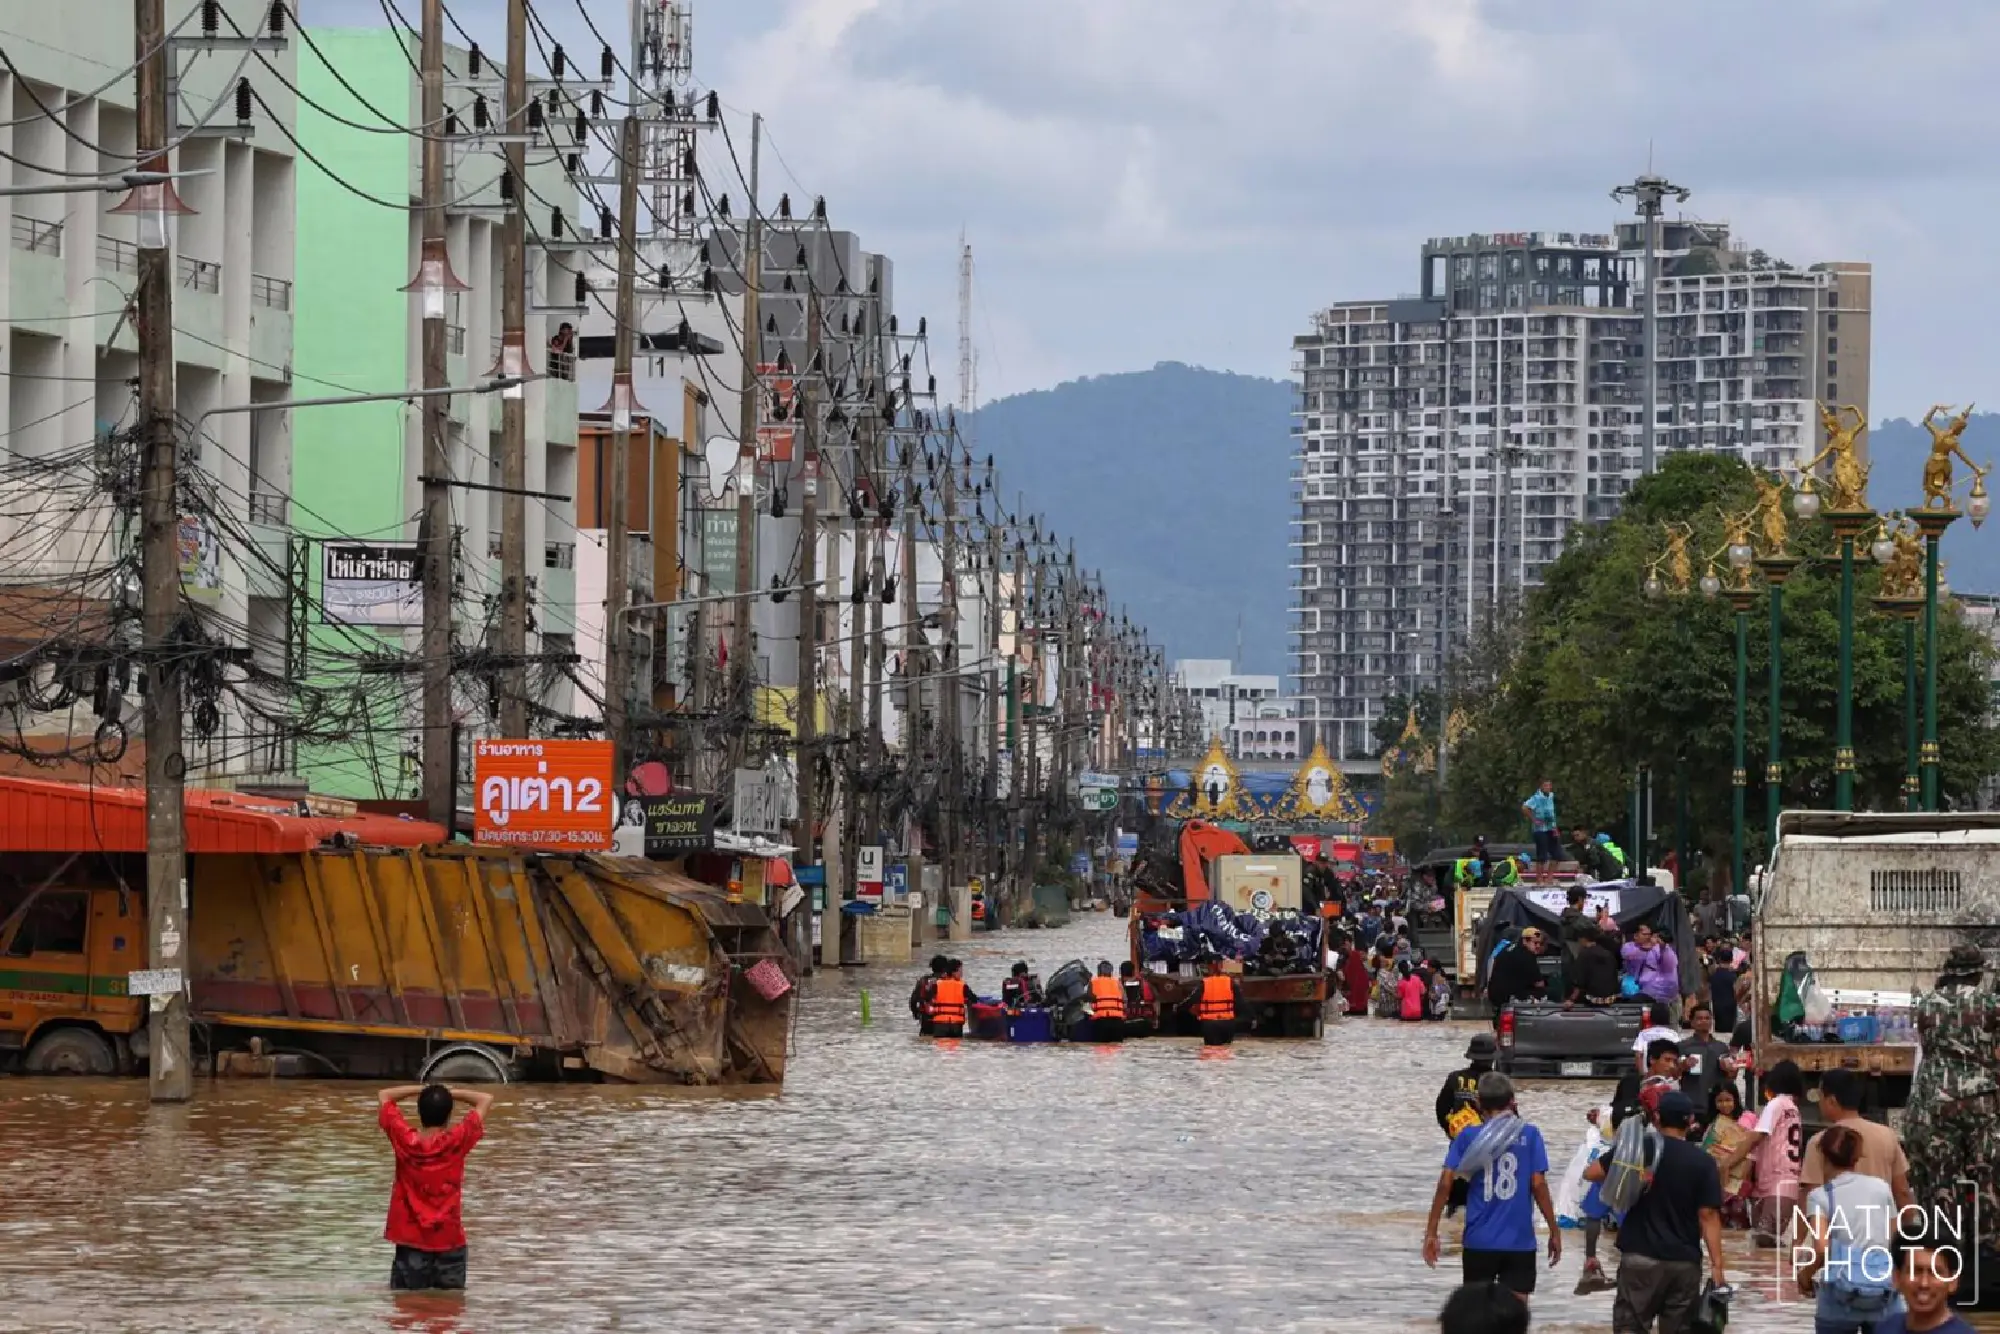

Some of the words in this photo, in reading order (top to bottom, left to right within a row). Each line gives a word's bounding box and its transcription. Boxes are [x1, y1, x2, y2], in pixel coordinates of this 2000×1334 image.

[478, 740, 543, 757] ร้านอาหาร
[1483, 1152, 1518, 1202] 18
